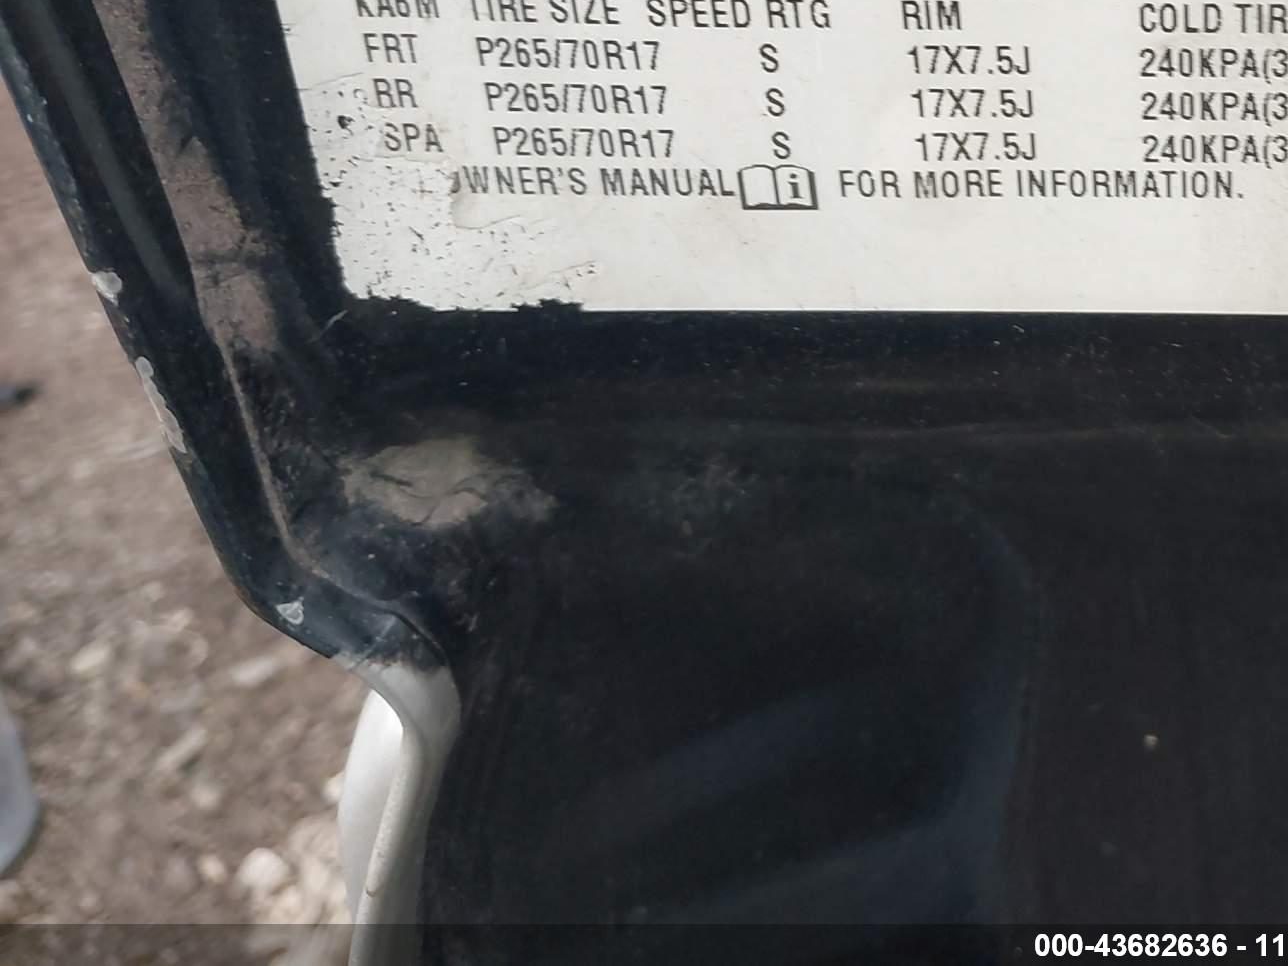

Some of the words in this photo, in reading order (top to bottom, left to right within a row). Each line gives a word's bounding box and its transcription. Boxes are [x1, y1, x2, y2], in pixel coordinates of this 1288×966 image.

[901, 0, 963, 31] RIM
[1139, 2, 1222, 35] COLD
[363, 32, 419, 64] FRT
[475, 36, 660, 71] P265/70R17
[759, 42, 780, 74] S
[907, 44, 1031, 76] 17X7.5J
[484, 81, 668, 116] P265/70R17
[765, 87, 786, 119] S
[911, 88, 1034, 119] 17X7.5J
[384, 122, 444, 153] SPA
[492, 126, 675, 160] P265/70R17
[771, 130, 793, 162] S
[915, 131, 1037, 162] 17X7.5J
[600, 167, 736, 197] MANUAL
[839, 169, 902, 199] FOR
[913, 169, 1004, 199] MORE
[1017, 169, 1244, 199] INFORMATION.
